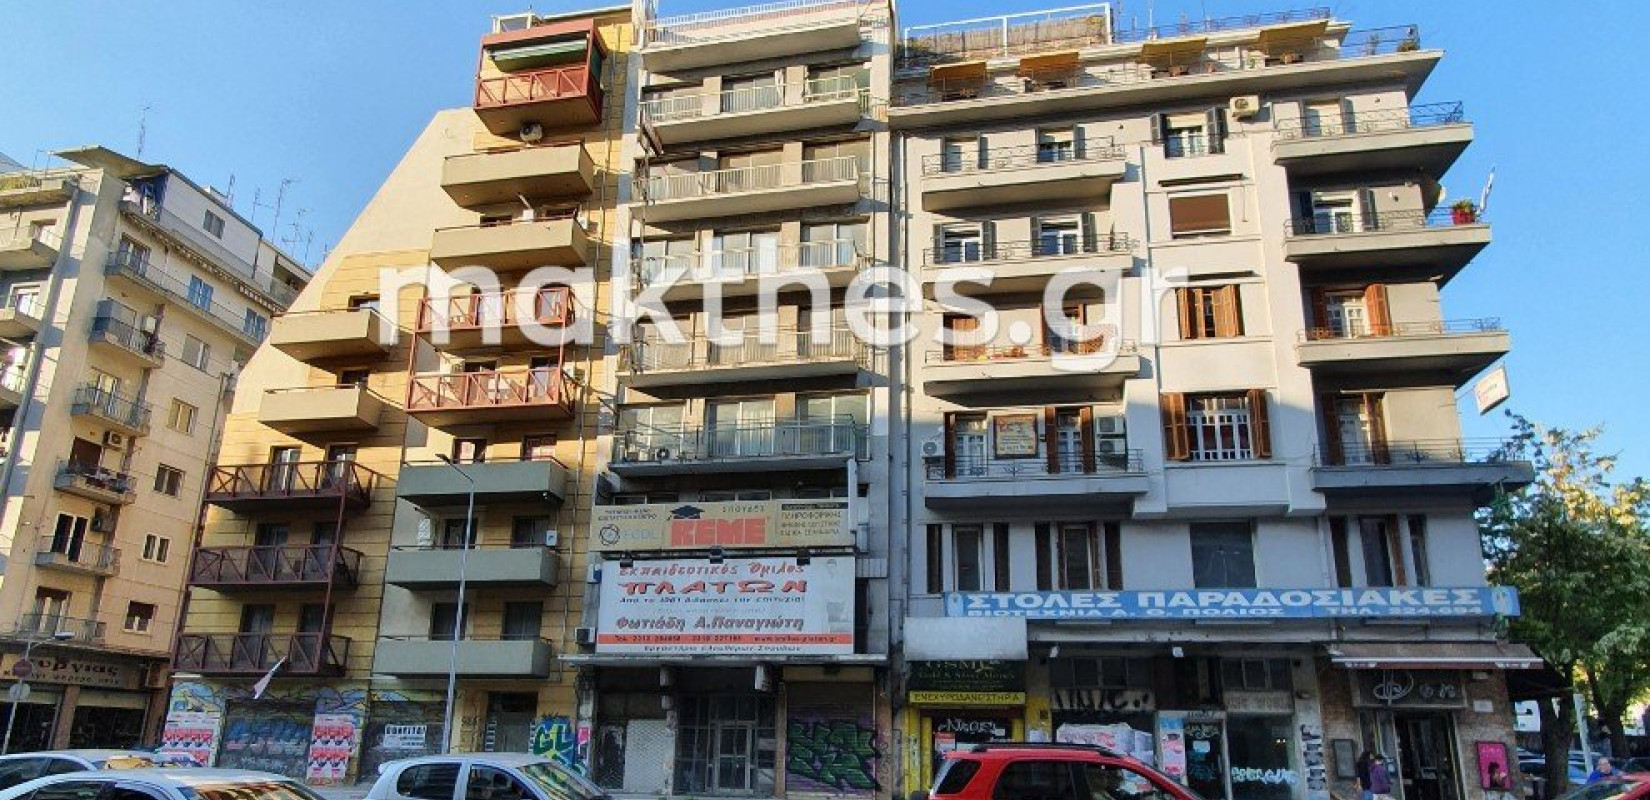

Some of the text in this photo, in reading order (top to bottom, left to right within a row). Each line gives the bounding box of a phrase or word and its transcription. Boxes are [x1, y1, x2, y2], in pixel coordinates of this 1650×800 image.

[617, 580, 808, 596] ΠΛΑΤΩΝ
[967, 589, 1482, 609] ΣΤΟΛΕΣ ΠΑΡΑΔΟΣΙΑΚΕΣ
[1327, 606, 1381, 615] ΤΗΛ.
[616, 616, 685, 632] Φωτιάδη
